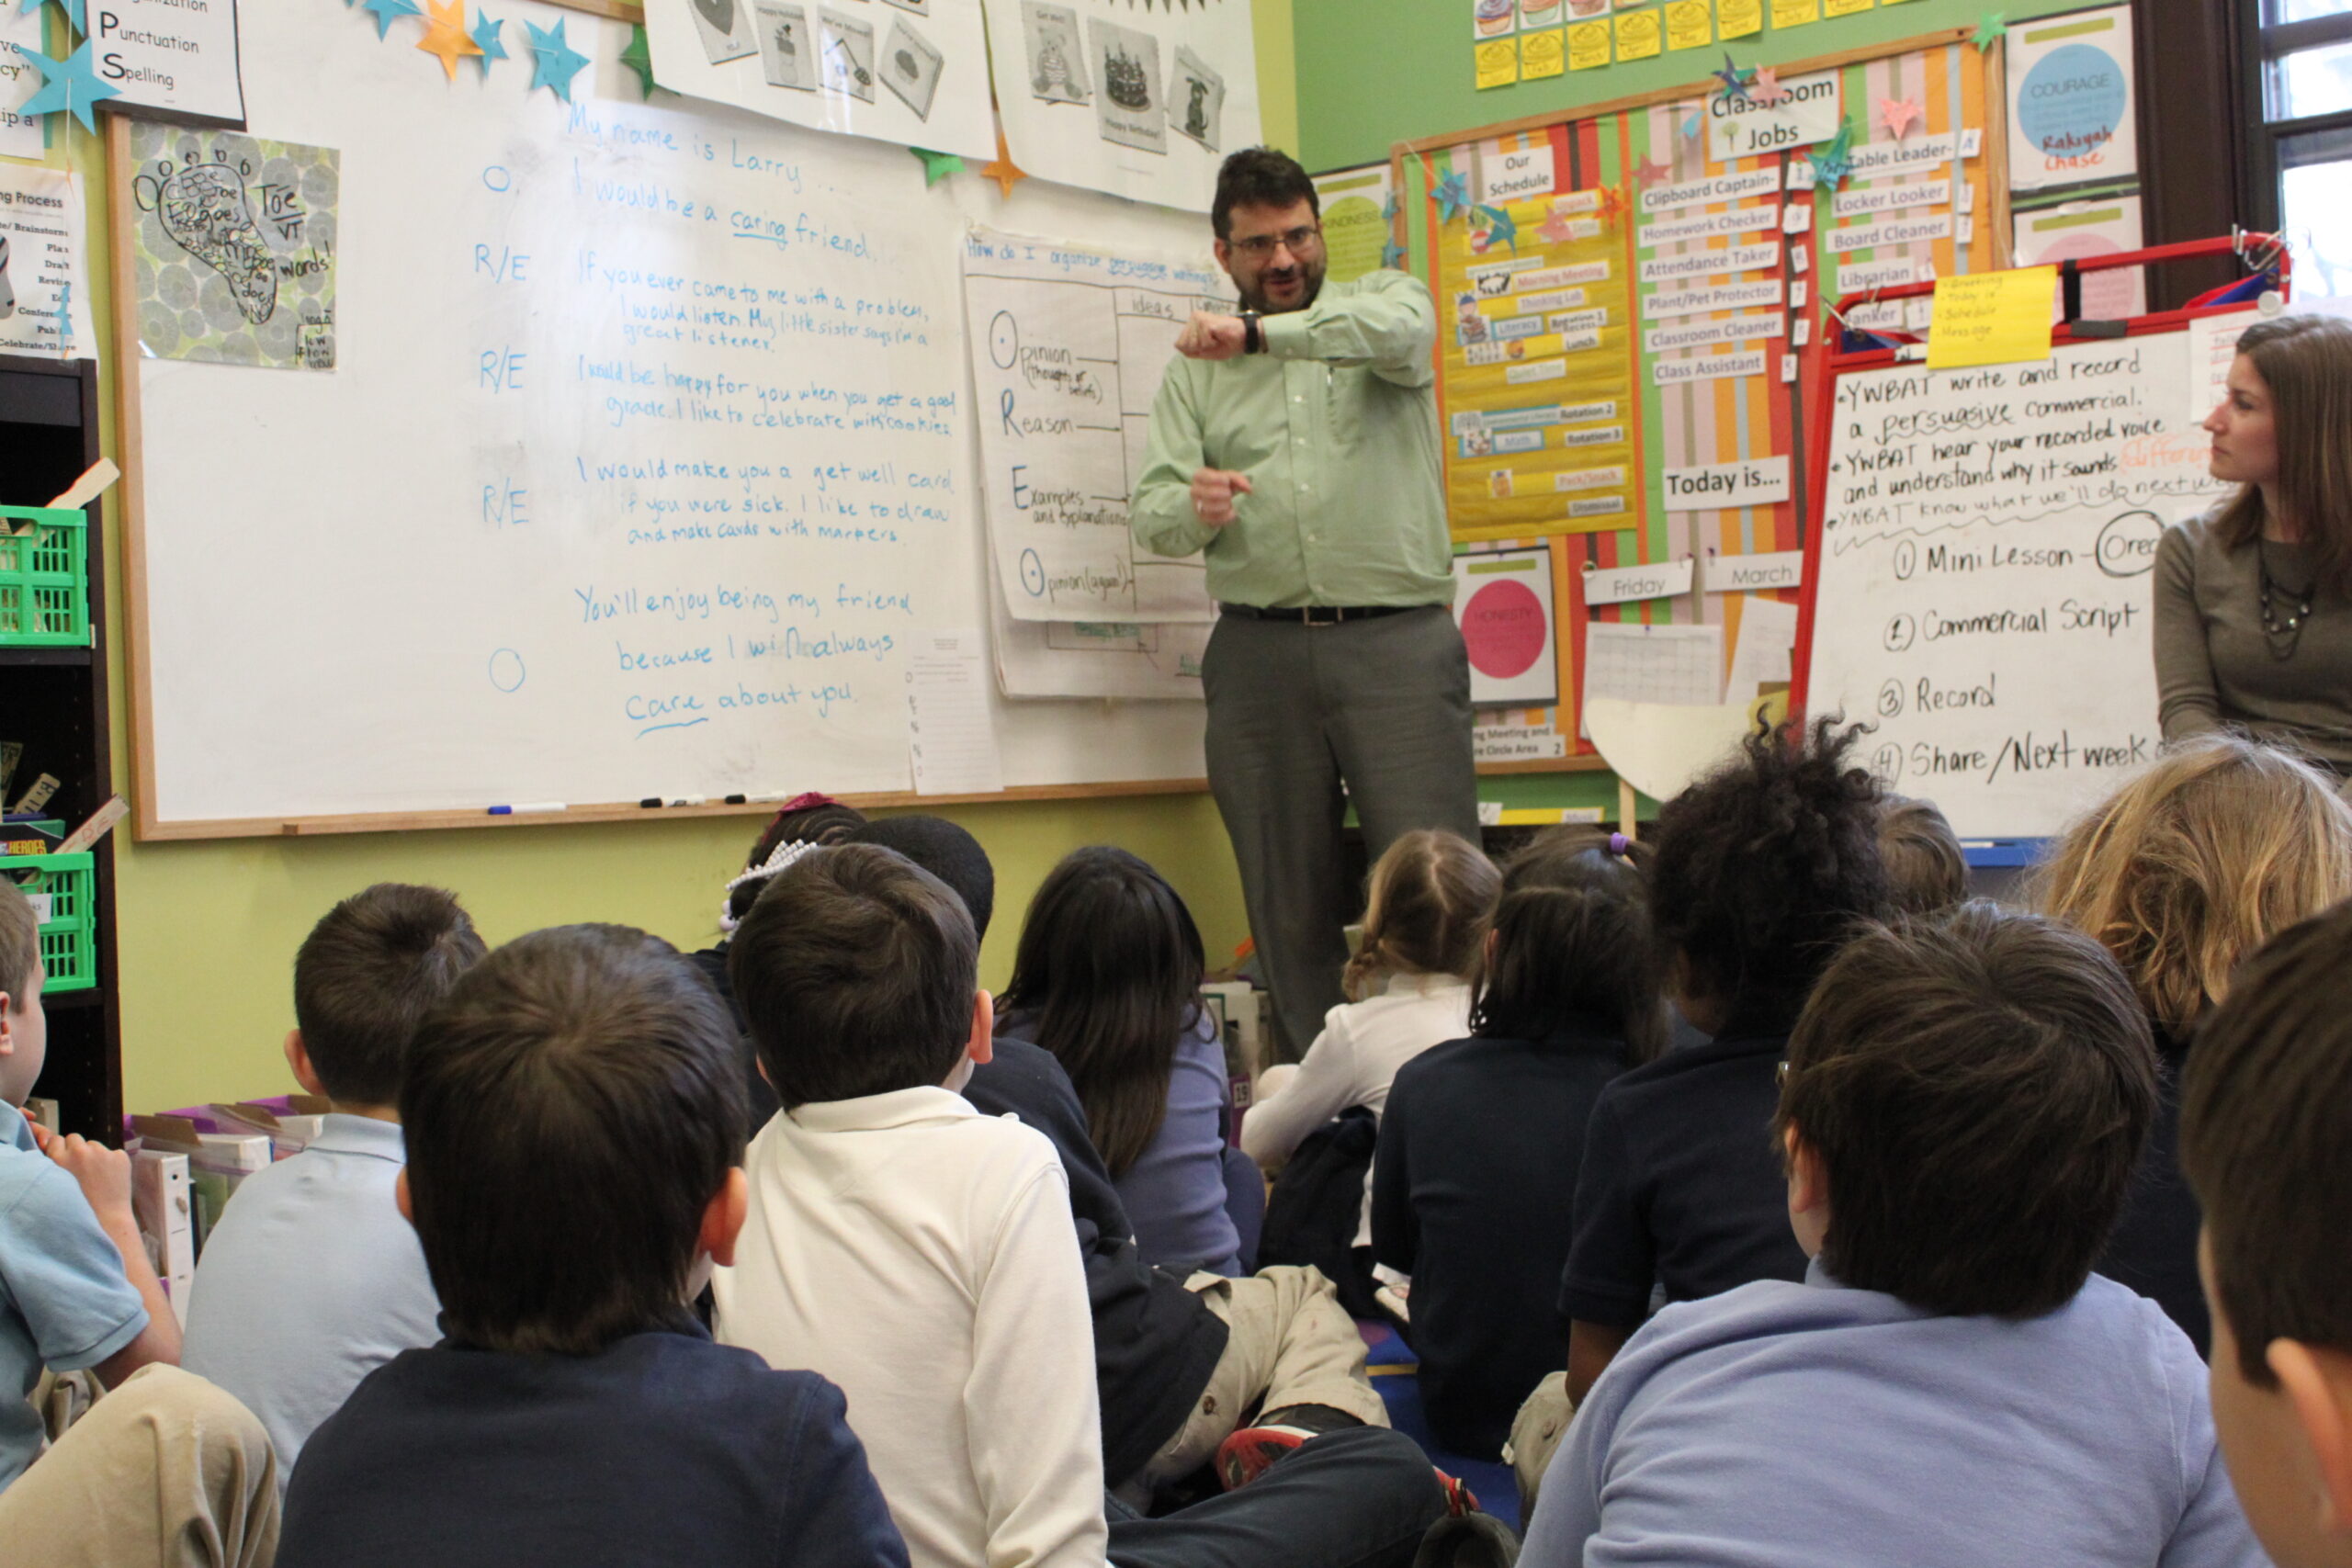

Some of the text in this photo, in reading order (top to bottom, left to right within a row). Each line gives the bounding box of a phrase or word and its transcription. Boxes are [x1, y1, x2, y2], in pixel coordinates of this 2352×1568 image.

[100, 11, 199, 53] Punctuation
[101, 53, 175, 90] Spelling
[2030, 73, 2109, 99] COURAGE
[568, 101, 714, 161] My name is
[1748, 123, 1799, 150] Jobs
[1505, 155, 1530, 170] Our
[1489, 174, 1549, 197] Schedule
[1644, 180, 1712, 207] Clipboard
[1836, 186, 1943, 212] Locker Looker
[16, 192, 63, 209] Process
[597, 180, 786, 251] would be a caring
[1644, 212, 1771, 241] Homework Checker
[1834, 221, 1945, 248] Board Cleaner
[475, 243, 530, 284] R/E
[967, 239, 994, 260] How
[1001, 245, 1014, 260] do
[1645, 248, 1773, 276] Attendance Taker
[604, 268, 828, 305] you ever came to me with
[1840, 265, 1909, 288] Librarian
[1648, 286, 1776, 310] Plant/Pet Protector
[623, 323, 684, 345] great
[633, 302, 776, 339] would My
[1650, 321, 1777, 347] Classroom Cleaner
[1566, 336, 1596, 350] Lunch
[481, 344, 527, 394] R/E
[1655, 356, 1761, 380] Class Assistant
[1846, 348, 2141, 411] YWBAT write and record
[589, 361, 868, 418] would be happy for you when you
[691, 399, 845, 429] like to celebrate
[1001, 388, 1073, 438] Reason
[1561, 406, 1603, 419] Rotation
[1849, 423, 1862, 438] a
[1875, 402, 2014, 446] persuasive
[1567, 432, 1611, 444] Rotation
[1846, 419, 2165, 476] YWBAT hear your recorded voice
[597, 458, 896, 493] would make you a get well
[1012, 465, 1084, 512] Examples
[1668, 469, 1736, 494] Today
[1844, 453, 2118, 504] and understand why it sounds
[483, 477, 529, 529] R/E
[646, 495, 949, 524] you were like to draw
[1920, 502, 1967, 518] know
[1974, 493, 2032, 511] what
[2040, 484, 2090, 504] we'll
[2098, 479, 2129, 499] do
[2135, 477, 2188, 494] next
[1033, 509, 1055, 524] and
[628, 519, 808, 544] and with
[1928, 543, 2074, 573] Mini Lesson
[1613, 578, 1666, 597] Friday
[1732, 566, 1792, 584] March
[575, 583, 912, 623] You'll enjoy being my friend
[1924, 599, 2139, 640] Commercial Script
[616, 631, 894, 671] because always
[718, 682, 800, 708] about
[1917, 672, 1996, 713] Record
[1487, 727, 1528, 739] Meeting
[1487, 744, 1512, 755] Circle
[1516, 743, 1538, 753] Area
[1555, 742, 1561, 755] 2
[2084, 734, 2146, 766] week
[8, 840, 48, 854] HEROES
